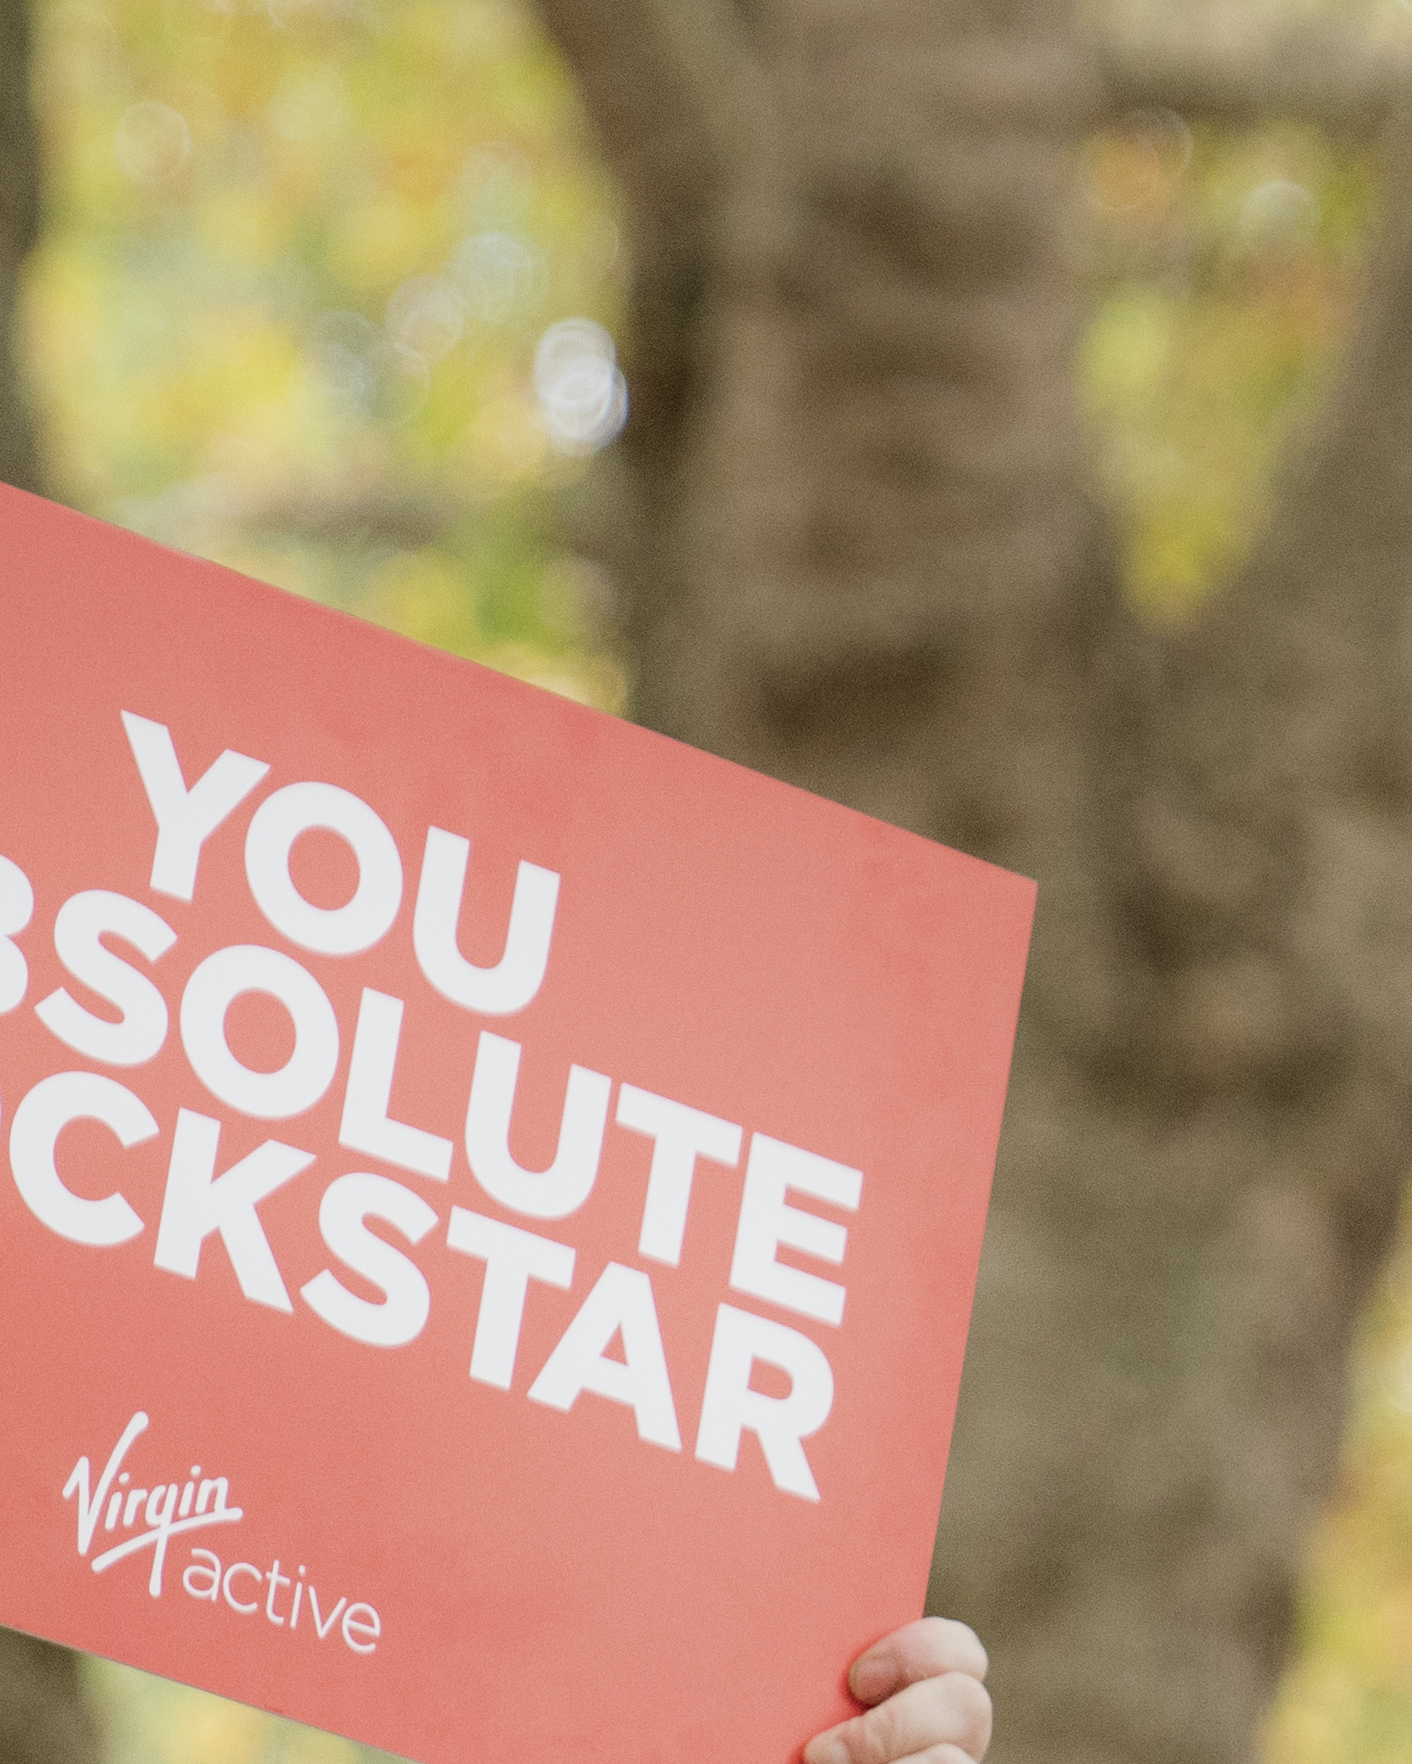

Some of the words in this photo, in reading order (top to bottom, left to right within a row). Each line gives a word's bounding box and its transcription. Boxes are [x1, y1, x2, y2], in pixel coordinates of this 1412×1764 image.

[121, 709, 563, 1019] YOU
[62, 1411, 243, 1598] Virgin
[183, 1548, 382, 1655] active
